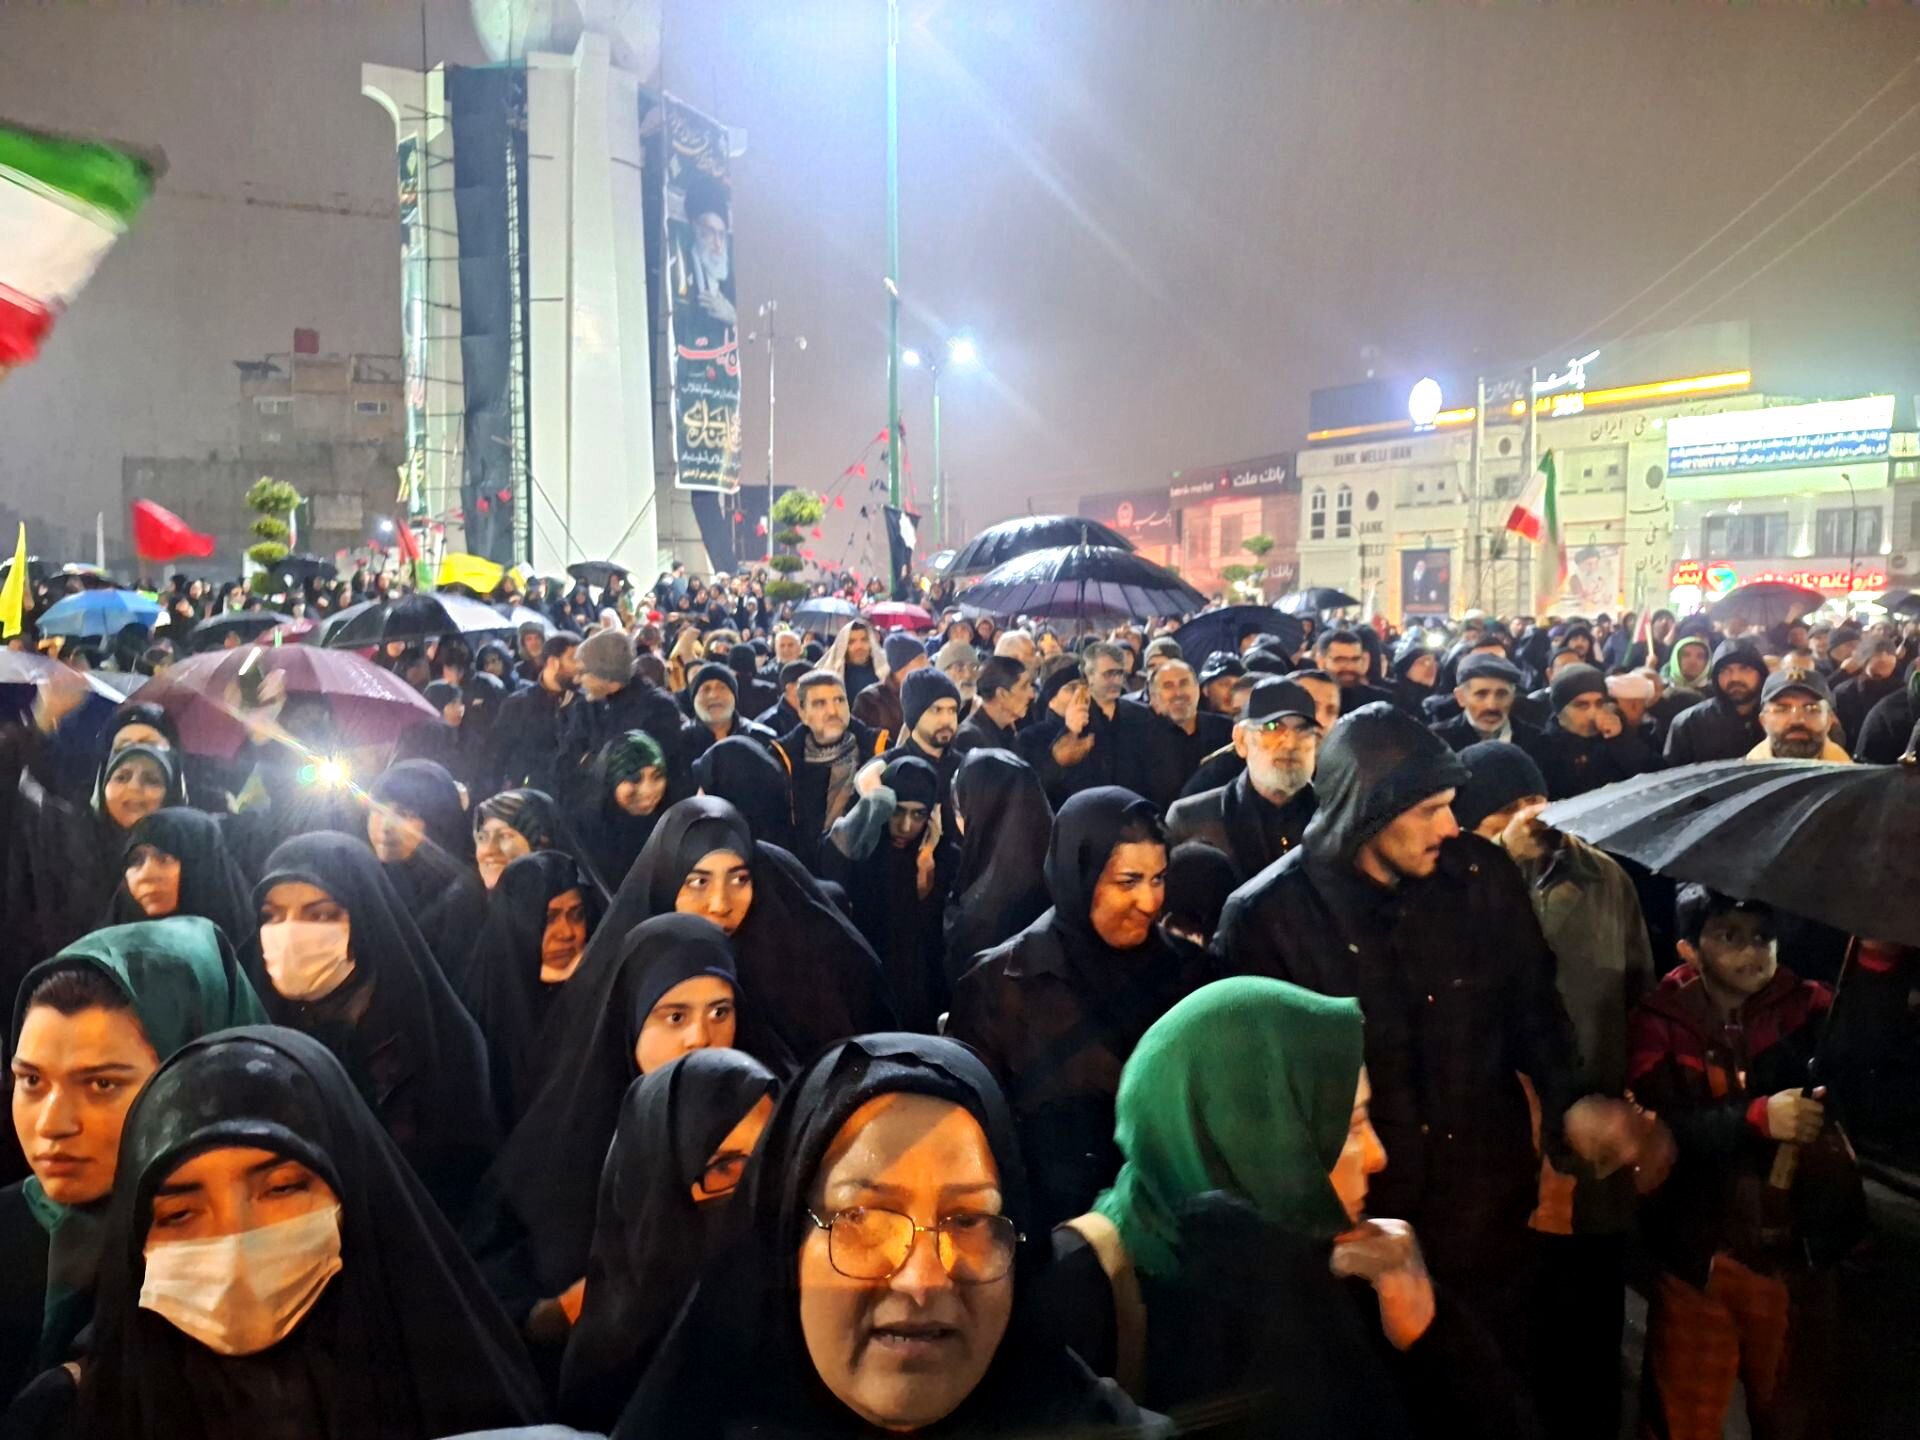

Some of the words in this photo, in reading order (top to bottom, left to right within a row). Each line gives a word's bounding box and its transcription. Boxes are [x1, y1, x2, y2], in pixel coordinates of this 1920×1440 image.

[1589, 418, 1623, 441] ایران
[1334, 452, 1357, 467] BANK
[1359, 447, 1388, 464] MELLI
[1390, 445, 1413, 460] IRAN
[1233, 471, 1258, 487] ملت
[1259, 466, 1286, 484] بانک
